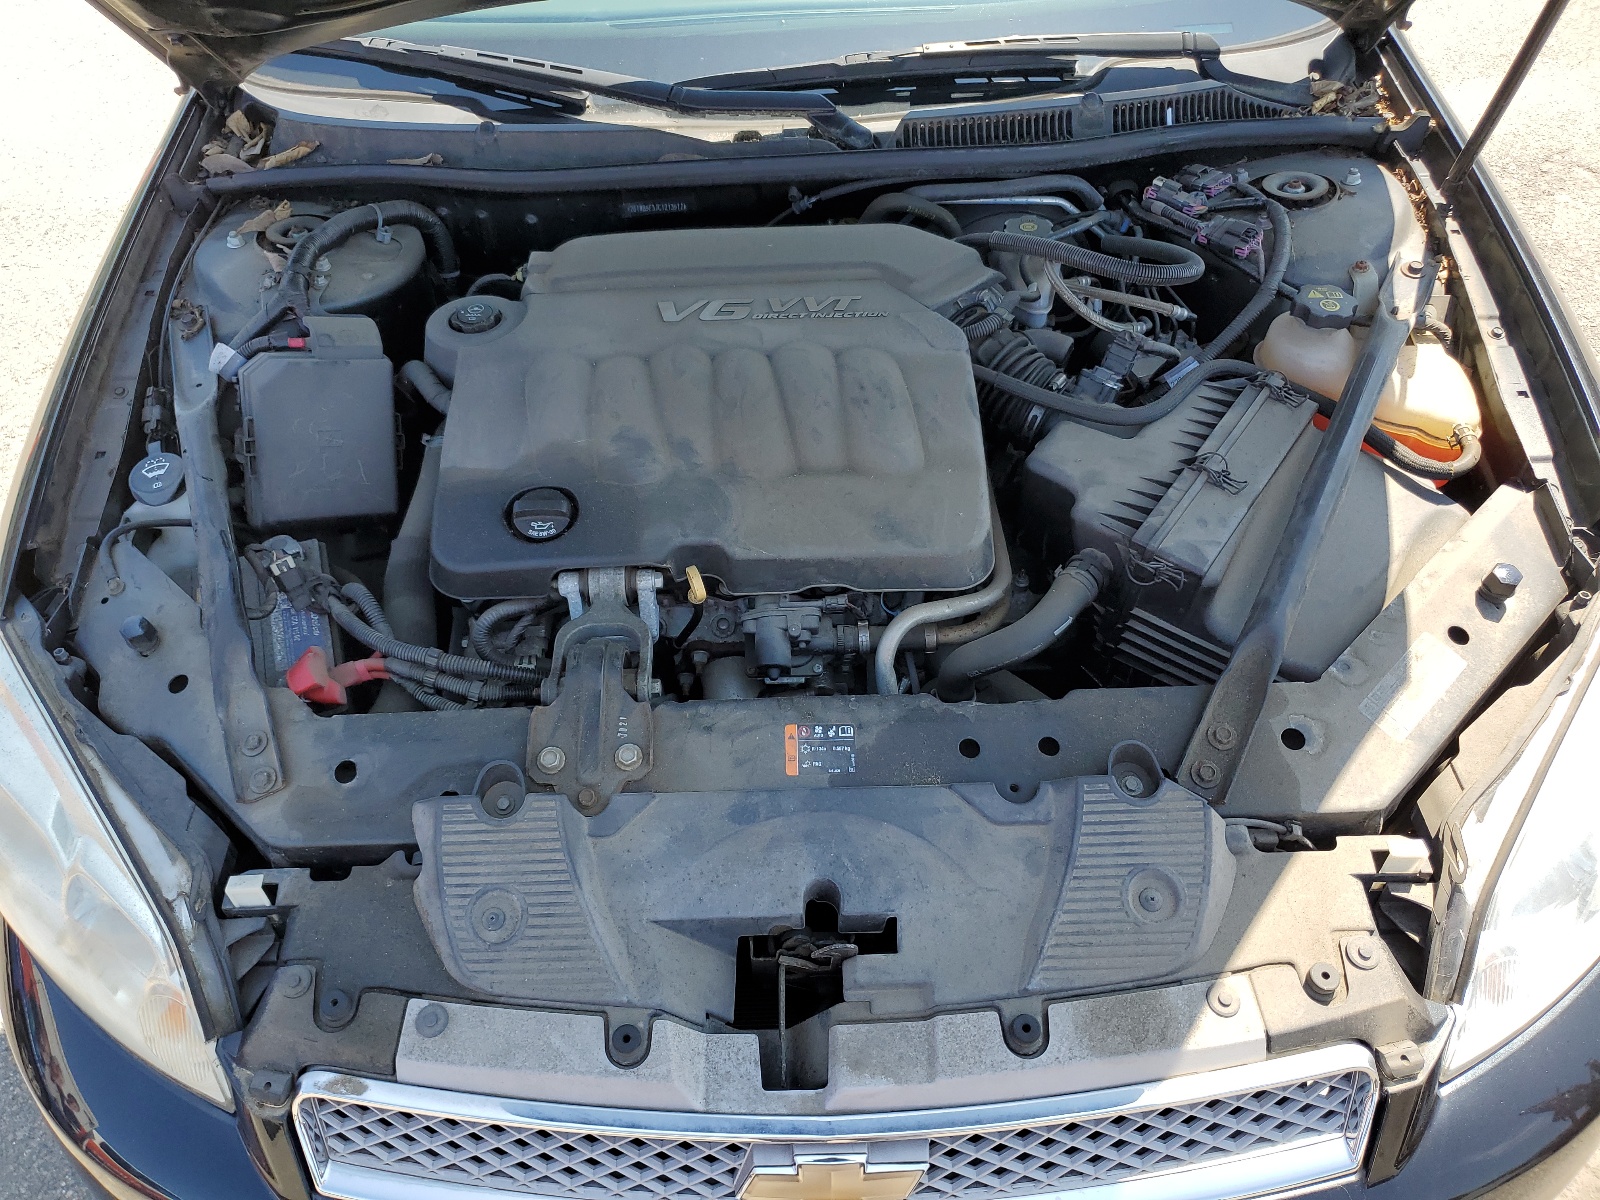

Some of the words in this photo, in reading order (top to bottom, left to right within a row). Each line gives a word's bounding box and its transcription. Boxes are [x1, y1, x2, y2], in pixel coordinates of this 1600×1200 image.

[657, 298, 754, 322] V6
[768, 295, 862, 312] VVT
[751, 311, 809, 320] DIRECT
[809, 310, 890, 319] INJECTION
